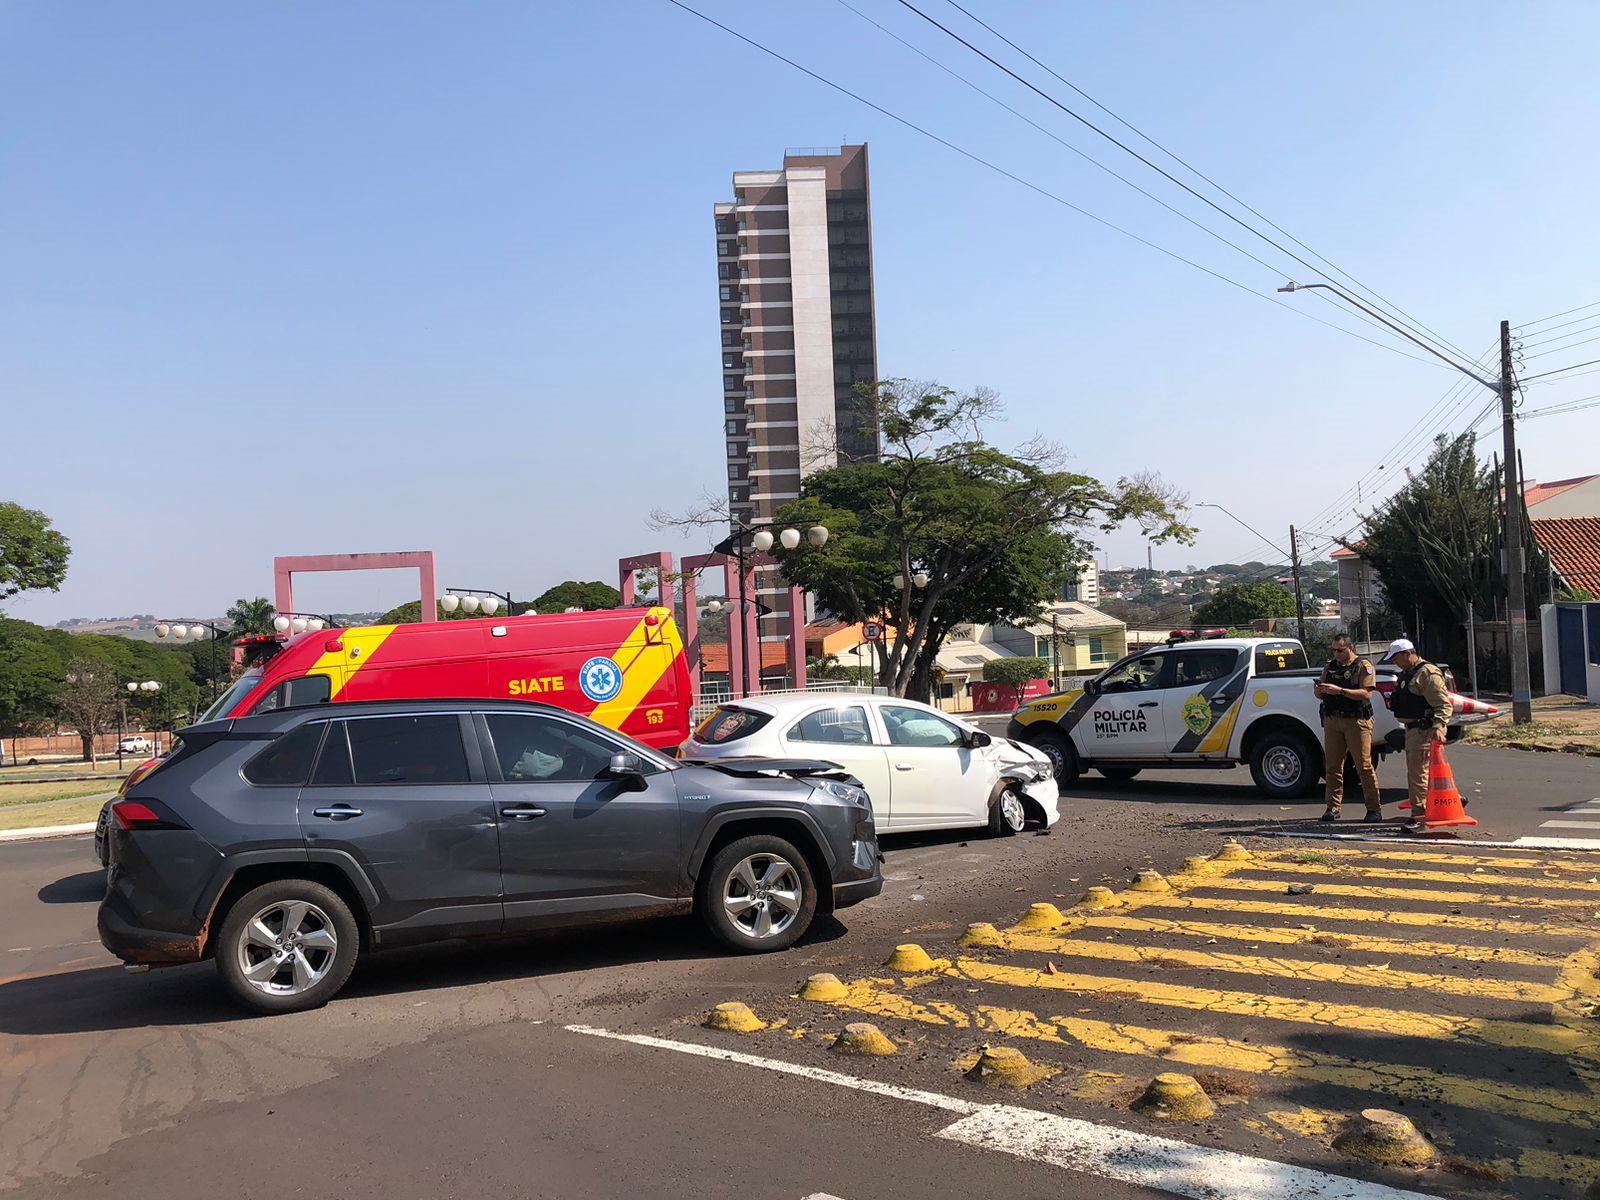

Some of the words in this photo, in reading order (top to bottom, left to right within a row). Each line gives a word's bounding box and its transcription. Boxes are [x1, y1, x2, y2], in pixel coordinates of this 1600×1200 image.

[508, 676, 565, 695] SIATE
[1033, 703, 1058, 712] 15520
[647, 715, 664, 724] 193
[1094, 721, 1148, 733] MILITAR
